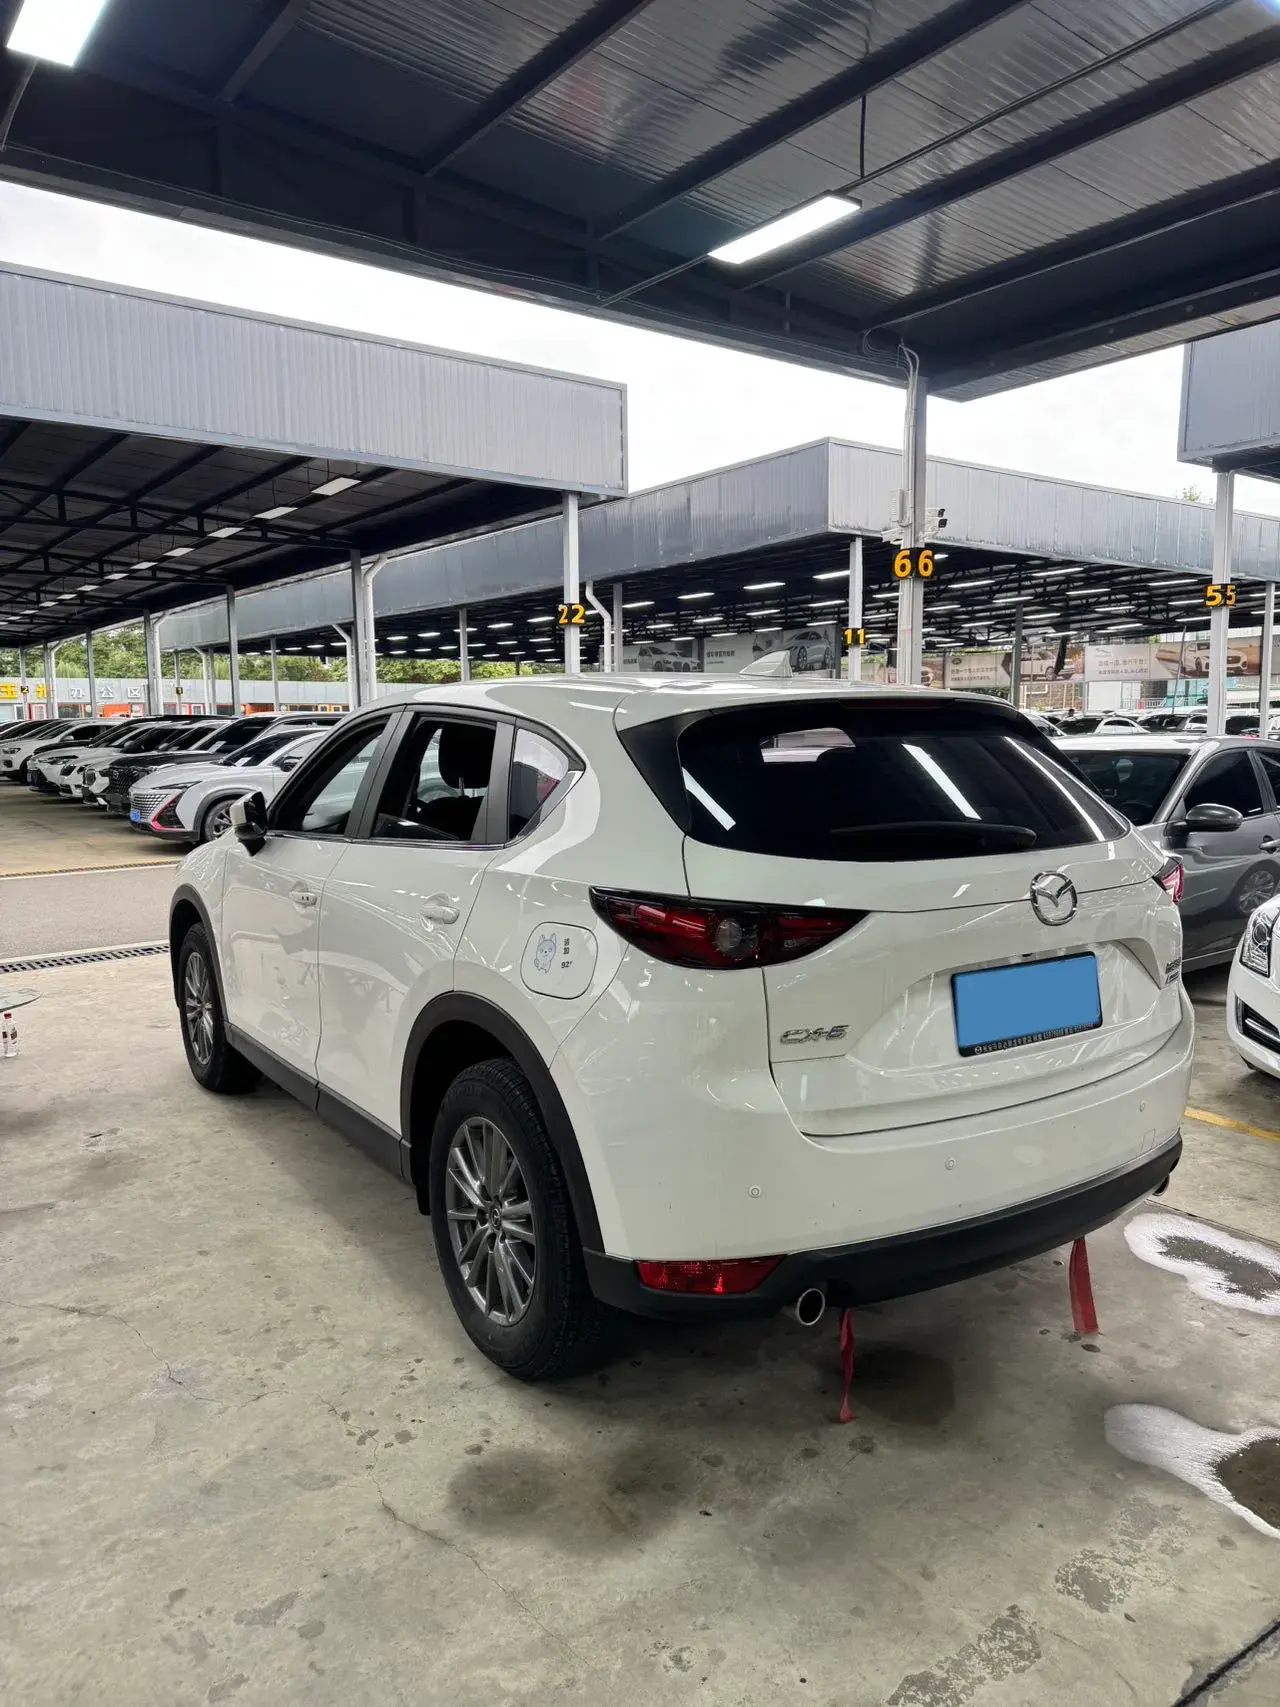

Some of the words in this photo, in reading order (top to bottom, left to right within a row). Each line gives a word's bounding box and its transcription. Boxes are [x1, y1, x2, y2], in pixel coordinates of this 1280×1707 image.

[71, 686, 141, 699] 办公区
[780, 1024, 849, 1044] CX-5
